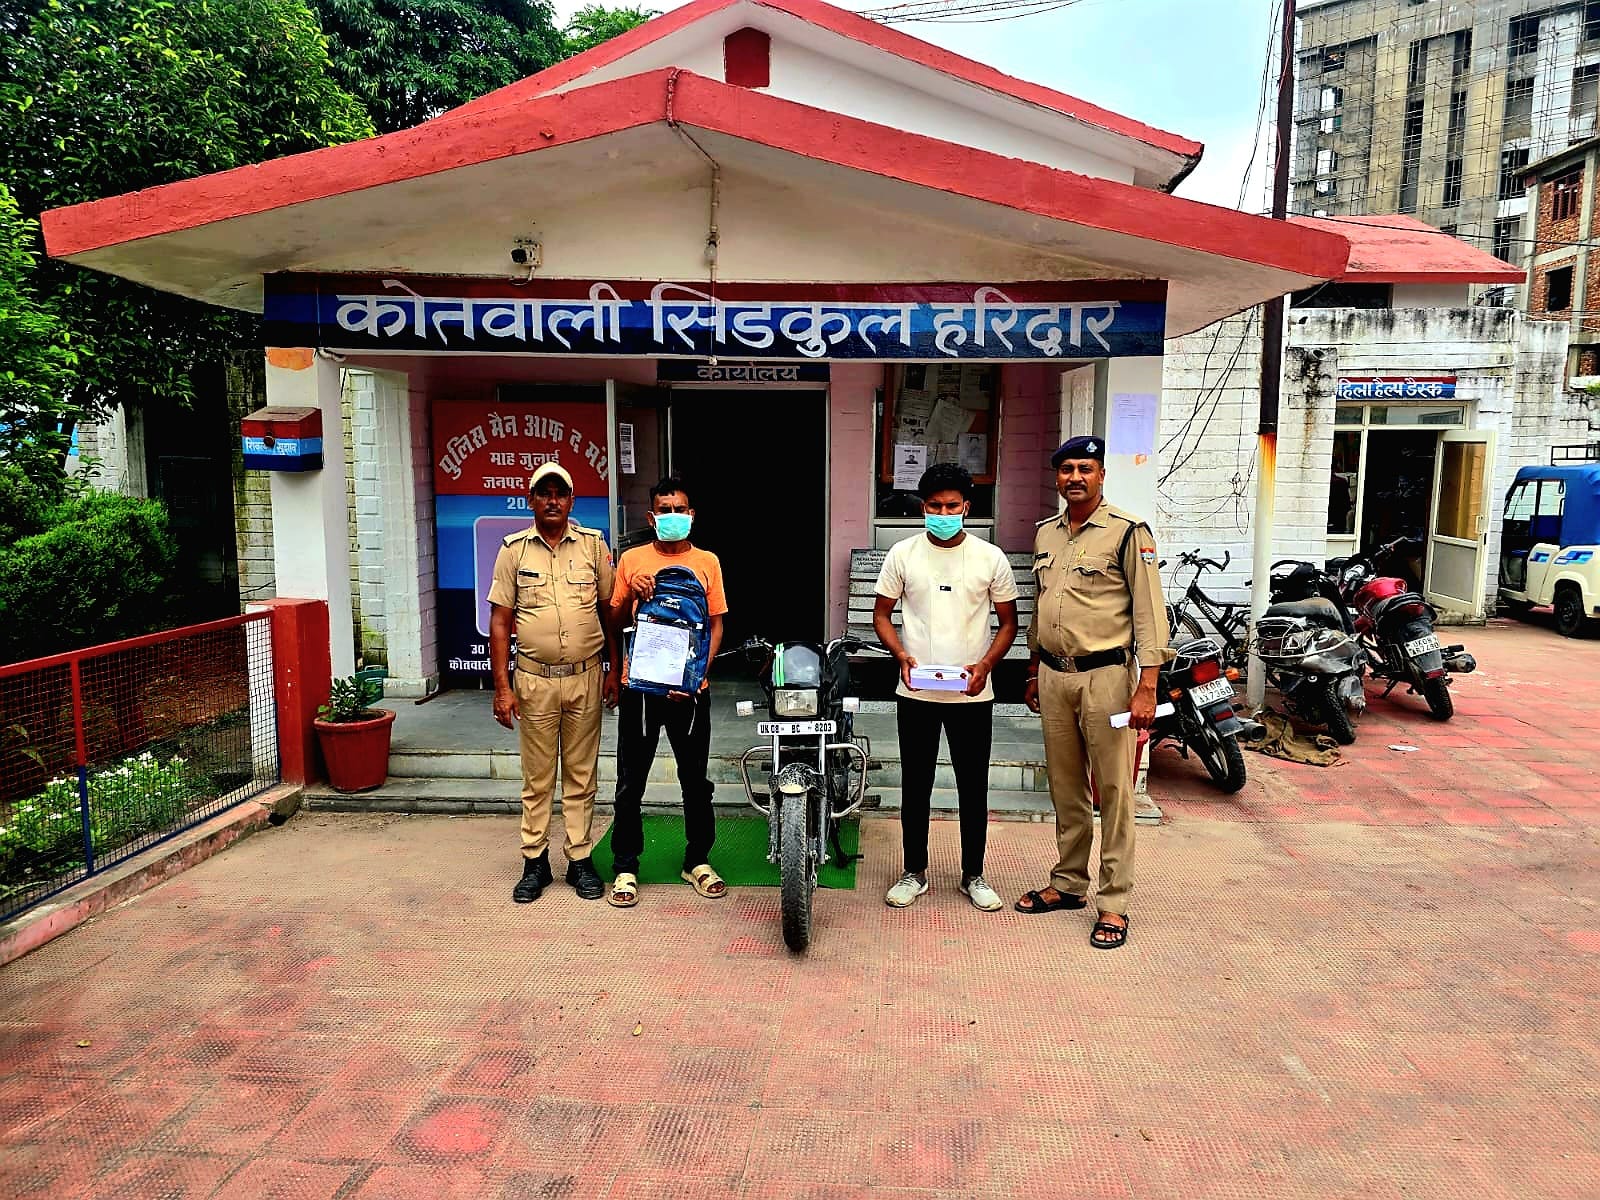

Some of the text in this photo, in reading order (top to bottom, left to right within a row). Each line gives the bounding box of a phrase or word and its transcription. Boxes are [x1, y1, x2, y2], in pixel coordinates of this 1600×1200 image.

[336, 280, 1121, 358] कोतवाली सिडकुल हरिद्वार
[1336, 378, 1371, 399] हिला
[439, 425, 488, 480] पुलिस
[569, 429, 582, 453] द
[489, 452, 515, 466] माह
[482, 477, 525, 489] जनपद
